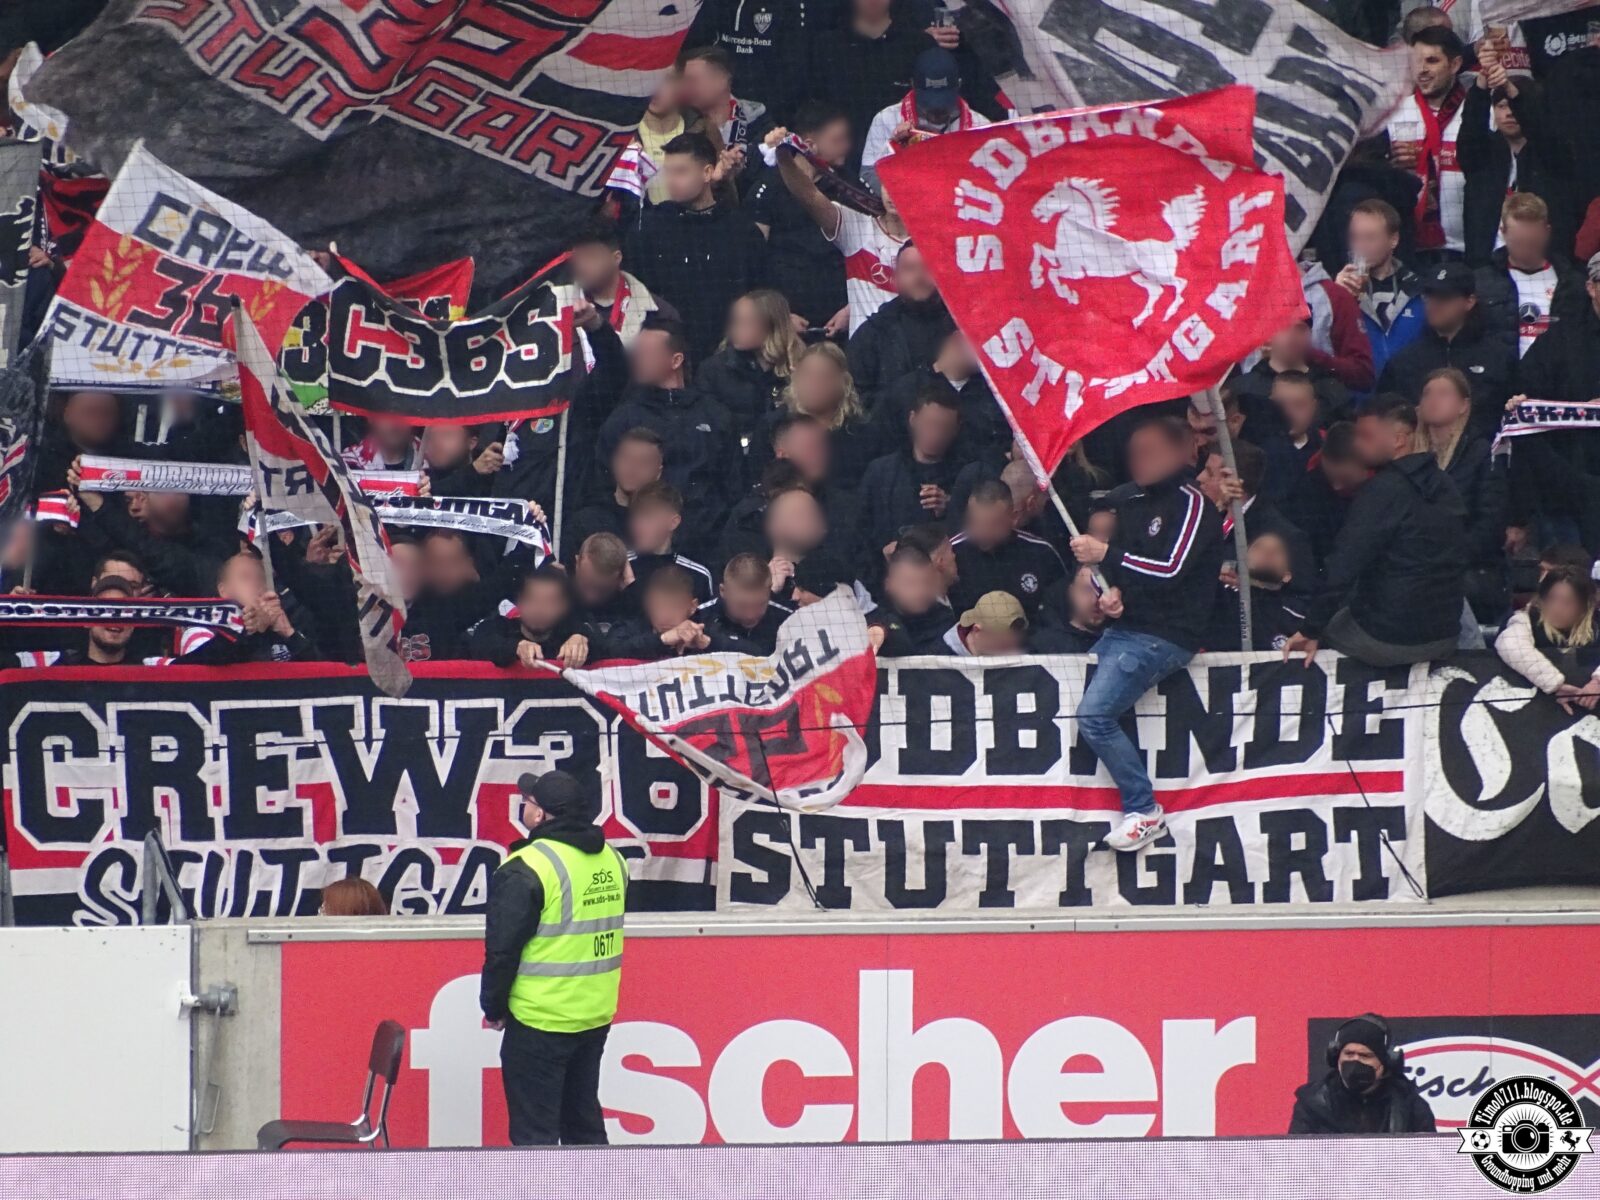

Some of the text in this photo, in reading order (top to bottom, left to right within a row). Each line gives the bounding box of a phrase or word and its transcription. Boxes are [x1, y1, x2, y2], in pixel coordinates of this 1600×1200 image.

[721, 33, 772, 46] Mercedes-Benz
[736, 45, 754, 54] Bank
[133, 191, 293, 279] CREW
[954, 108, 1236, 274] SÜDBAND
[856, 658, 1407, 778] DBNDE
[592, 871, 614, 885] SDS
[729, 806, 1407, 911] STUTTGART
[593, 931, 615, 958] 0677
[409, 968, 1258, 1144] fscher
